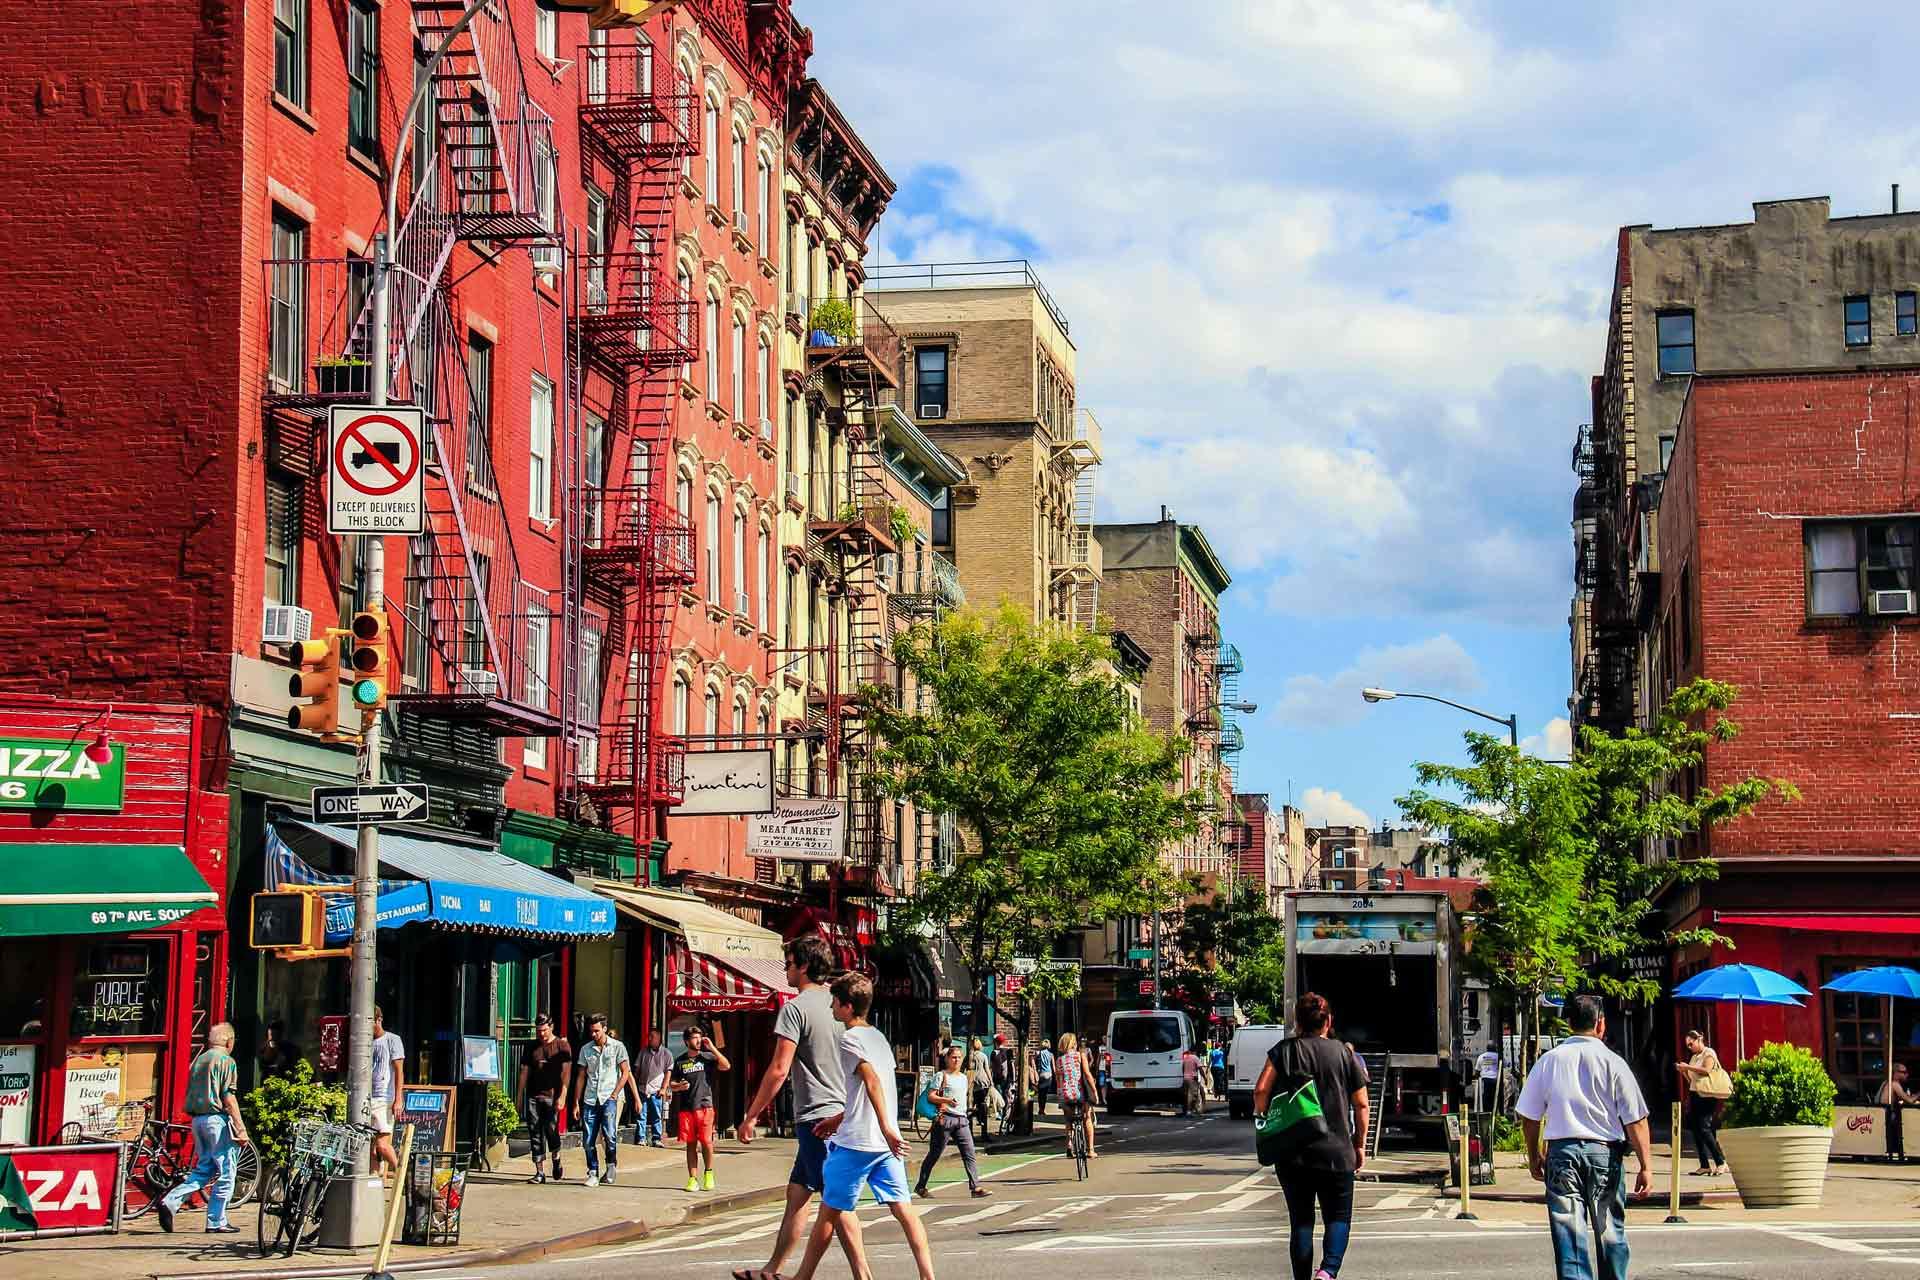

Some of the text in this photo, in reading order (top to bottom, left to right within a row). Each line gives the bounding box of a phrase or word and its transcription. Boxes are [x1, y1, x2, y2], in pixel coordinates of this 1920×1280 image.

[336, 502, 416, 512] EXCEPT DELIVERIES
[348, 516, 405, 527] THIS BLOCK
[324, 796, 414, 812] ONE WAY
[760, 824, 832, 836] MEAT MARKET
[91, 912, 107, 924] 69
[109, 911, 125, 923] 7th
[127, 909, 156, 922] AVE.
[376, 902, 427, 922] ESTAURANT
[94, 981, 145, 1005] PURPLE
[93, 1006, 144, 1022] HAZE
[69, 1069, 117, 1083] Draught
[80, 1088, 106, 1099] Beer
[18, 1170, 101, 1210] ZA
